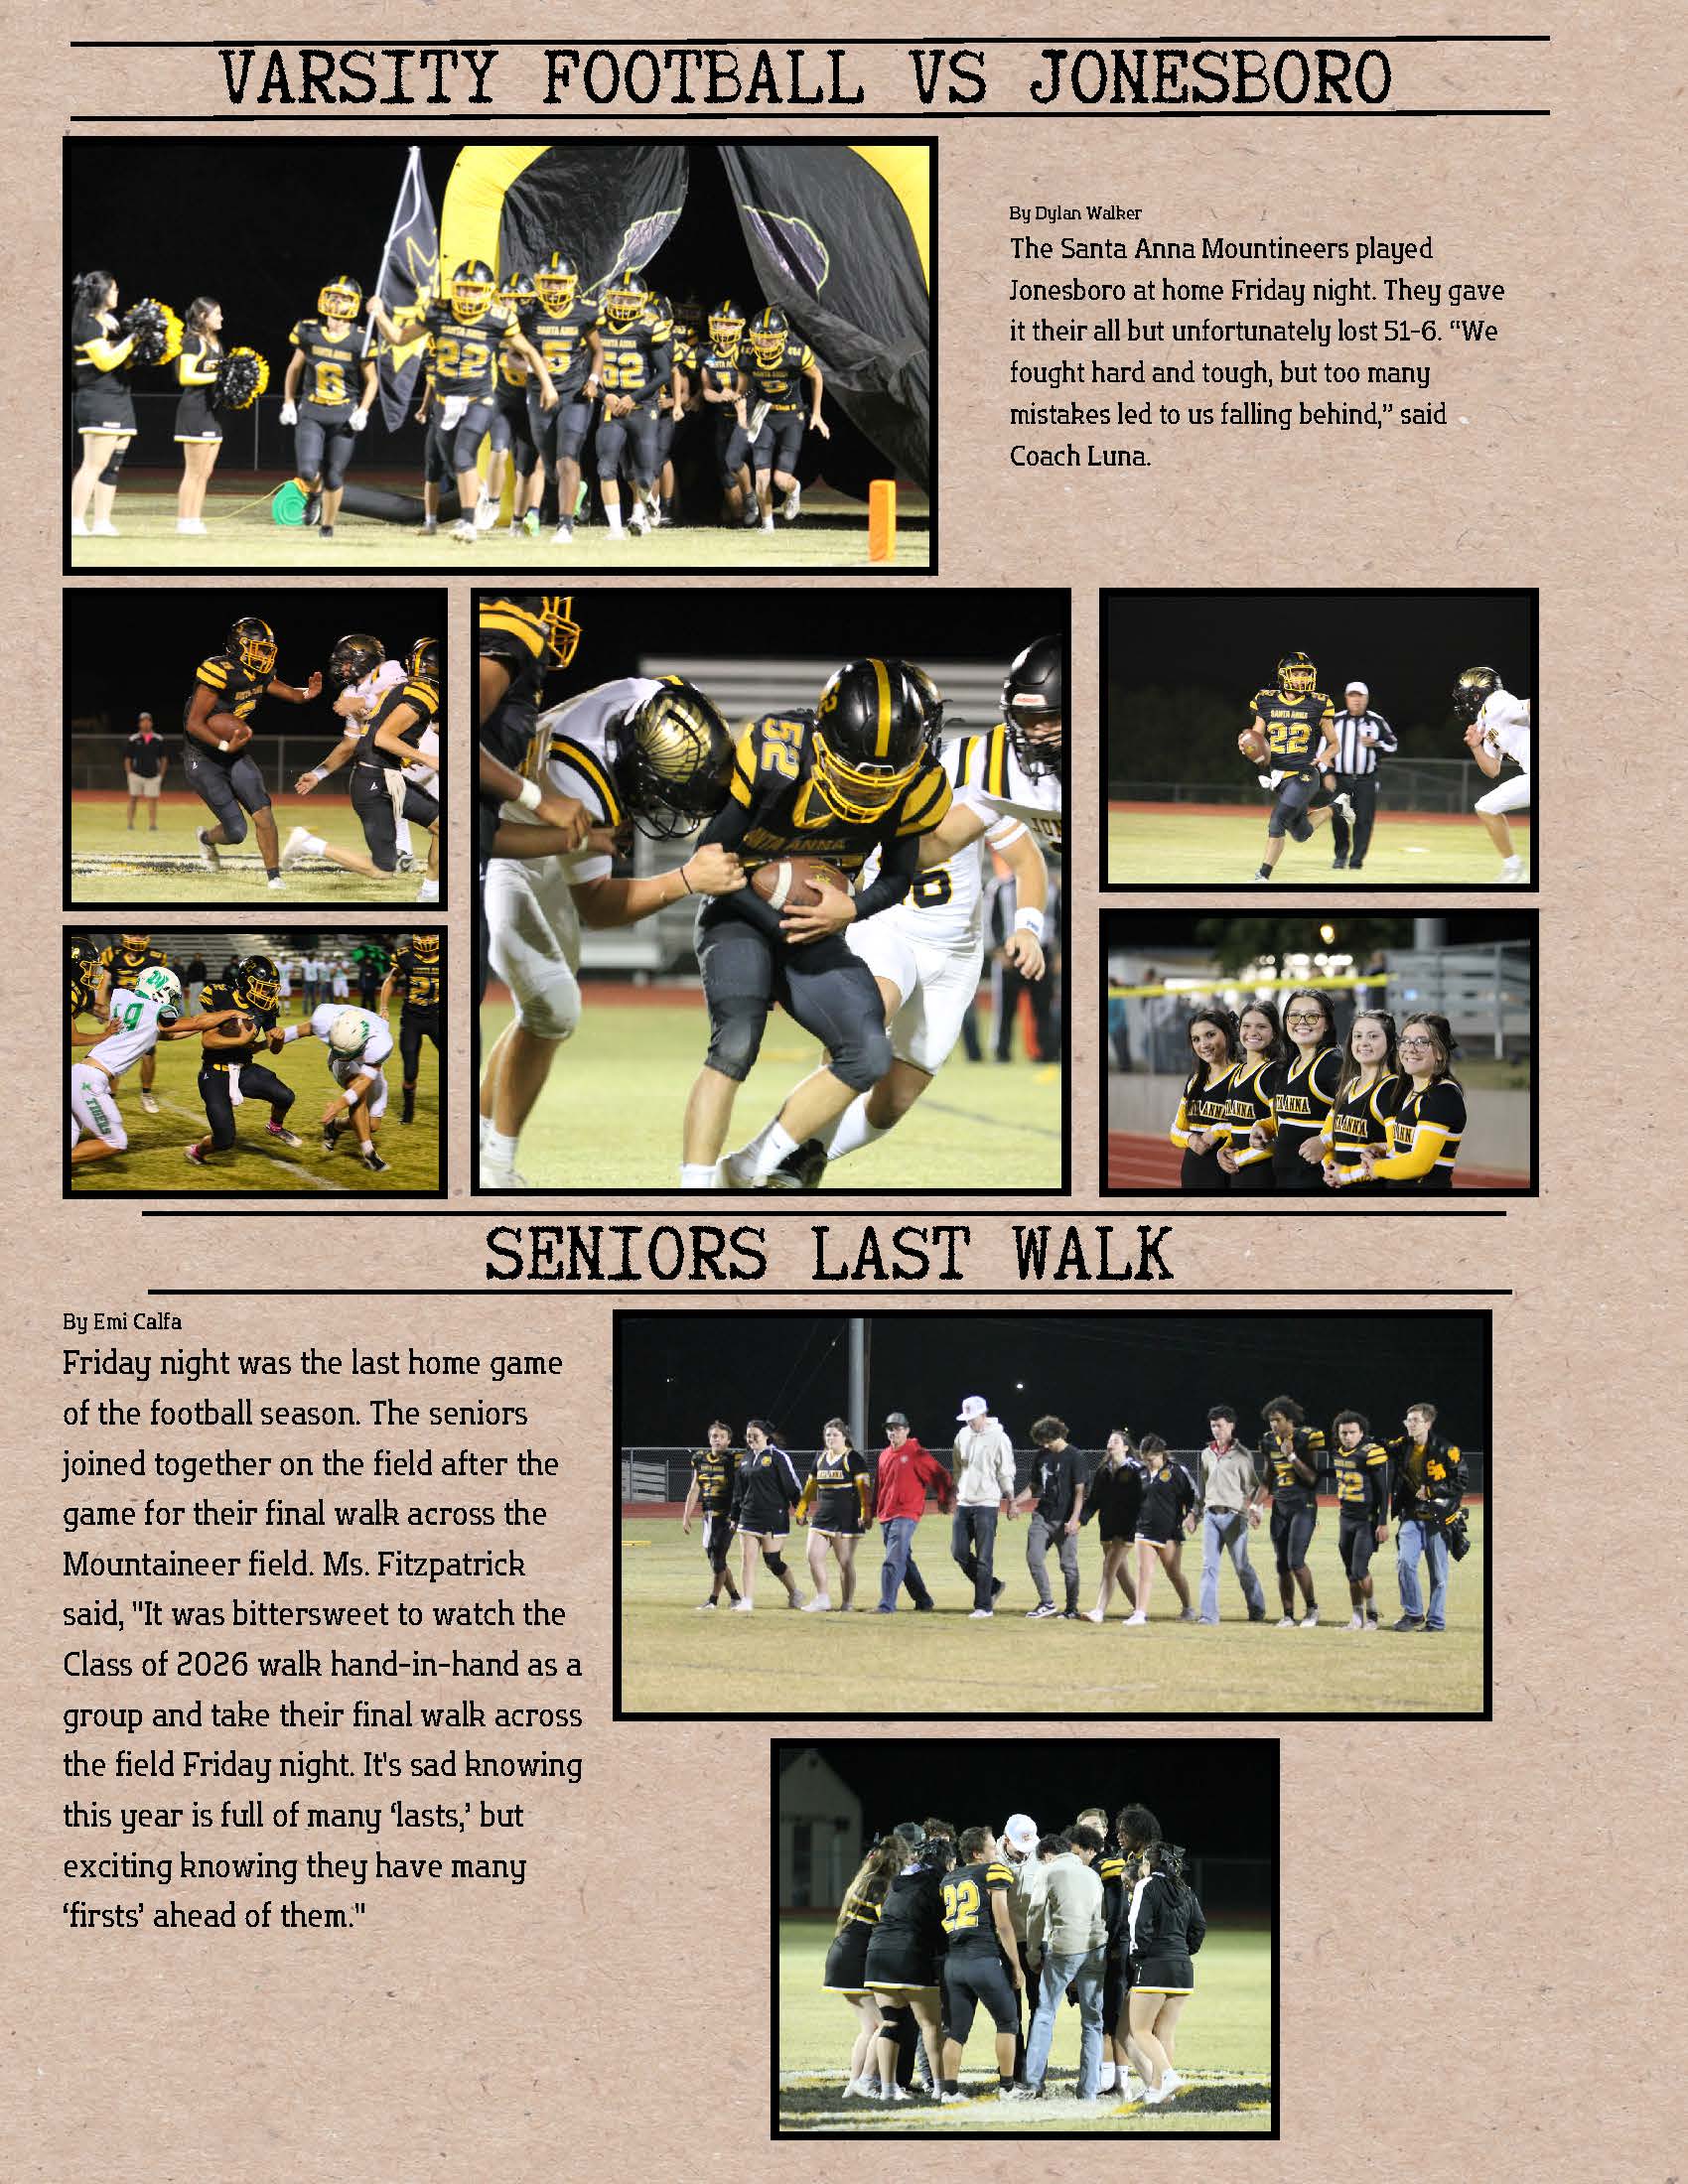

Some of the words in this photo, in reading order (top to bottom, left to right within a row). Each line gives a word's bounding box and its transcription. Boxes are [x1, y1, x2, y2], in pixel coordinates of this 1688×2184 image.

[218, 50, 498, 104] VARSITY
[543, 50, 864, 104] FOOTBALL
[909, 50, 986, 104] VS
[1030, 50, 1391, 104] JONESBORO
[1010, 206, 1031, 223] By
[1036, 205, 1081, 223] Dylan
[1086, 205, 1142, 219] Walker
[1011, 236, 1053, 258] The
[1061, 238, 1127, 258] Santa
[1135, 238, 1196, 258] Anna
[1202, 236, 1348, 258] Mountineers
[1356, 236, 1433, 264] played
[1010, 278, 1125, 300] Jonesboro
[1134, 281, 1155, 300] at
[1163, 278, 1223, 300] home
[1232, 278, 1305, 306] Friday
[1314, 278, 1376, 306] night.
[1384, 278, 1441, 306] They
[1449, 285, 1504, 306] gave
[1011, 319, 1025, 341] it
[1033, 319, 1087, 341] their
[1094, 319, 1120, 341] all
[1128, 319, 1164, 341] but
[1173, 319, 1331, 346] unfortunately
[1338, 319, 1377, 341] lost
[1385, 321, 1442, 341] 51-6.
[437, 338, 492, 378] 22
[542, 340, 573, 374] 5
[1011, 360, 1084, 388] fought
[1092, 360, 1145, 382] hard
[1153, 360, 1195, 382] and
[1202, 360, 1272, 388] tough,
[1281, 360, 1317, 382] but
[1325, 363, 1359, 382] too
[1368, 367, 1430, 388] many
[1011, 402, 1110, 424] mistakes
[1118, 402, 1152, 424] led
[1160, 405, 1180, 424] to
[1189, 409, 1213, 424] us
[1221, 402, 1292, 430] falling
[1401, 402, 1447, 424] said
[1011, 444, 1080, 466] Coach
[1088, 446, 1151, 466] Luna.
[762, 717, 805, 780] 52
[1267, 721, 1313, 754] 22
[487, 1226, 767, 1281] SENIORS
[811, 1226, 970, 1281] LAST
[1012, 1225, 1174, 1281] WALK
[64, 1313, 87, 1334] By
[94, 1312, 127, 1329] Emi
[134, 1312, 182, 1329] Calfa
[64, 1348, 151, 1381] Friday
[161, 1348, 229, 1381] night
[238, 1357, 291, 1374] was
[301, 1348, 342, 1374] the
[352, 1348, 399, 1374] last
[409, 1348, 480, 1374] home
[491, 1357, 562, 1381] game
[64, 1399, 89, 1425] of
[98, 1399, 140, 1425] the
[151, 1399, 252, 1425] football
[261, 1408, 360, 1425] season.
[370, 1399, 419, 1425] The
[430, 1400, 527, 1425] seniors
[62, 1449, 145, 1482] joined
[155, 1449, 271, 1482] together
[280, 1458, 313, 1475] on
[323, 1449, 363, 1475] the
[374, 1449, 432, 1475] field
[442, 1449, 507, 1475] after
[517, 1449, 558, 1475] the
[64, 1508, 135, 1532] game
[145, 1499, 185, 1525] for
[194, 1499, 257, 1525] their
[266, 1499, 325, 1525] final
[335, 1499, 399, 1525] walk
[408, 1508, 494, 1525] across
[504, 1499, 546, 1525] the
[64, 1551, 240, 1575] Mountaineer
[249, 1550, 314, 1575] field.
[324, 1552, 369, 1575] Ms.
[378, 1550, 525, 1582] Fitzpatrick
[64, 1599, 123, 1631] said,
[133, 1601, 162, 1625] "It
[172, 1608, 224, 1625] was
[233, 1599, 388, 1625] bittersweet
[398, 1603, 422, 1625] to
[433, 1599, 514, 1625] watch
[523, 1599, 565, 1625] the
[65, 1650, 132, 1676] Class
[142, 1650, 168, 1676] of
[178, 1652, 247, 1676] 2026
[258, 1650, 322, 1676] walk
[332, 1650, 518, 1676] hand-in-hand
[528, 1659, 557, 1676] as
[567, 1659, 582, 1676] a
[64, 1709, 142, 1733] group
[153, 1701, 202, 1726] and
[211, 1701, 269, 1726] take
[280, 1701, 344, 1726] their
[353, 1701, 412, 1726] final
[421, 1701, 486, 1726] walk
[495, 1709, 582, 1726] across
[64, 1750, 105, 1776] the
[116, 1750, 174, 1776] field
[184, 1750, 271, 1783] Friday
[280, 1750, 354, 1783] night.
[364, 1752, 401, 1776] It's
[411, 1750, 456, 1776] sad
[466, 1750, 582, 1783] knowing
[64, 1801, 111, 1827] this
[121, 1810, 183, 1834] year
[193, 1802, 212, 1827] is
[221, 1801, 263, 1827] full
[273, 1801, 299, 1827] of
[308, 1810, 381, 1834] many
[481, 1801, 523, 1827] but
[65, 1852, 172, 1884] exciting
[181, 1851, 298, 1884] knowing
[307, 1851, 367, 1884] they
[376, 1851, 442, 1877] have
[452, 1860, 526, 1884] many
[154, 1901, 235, 1927] ahead
[245, 1901, 271, 1927] of
[281, 1901, 364, 1927] them."
[940, 1879, 981, 1935] 22
